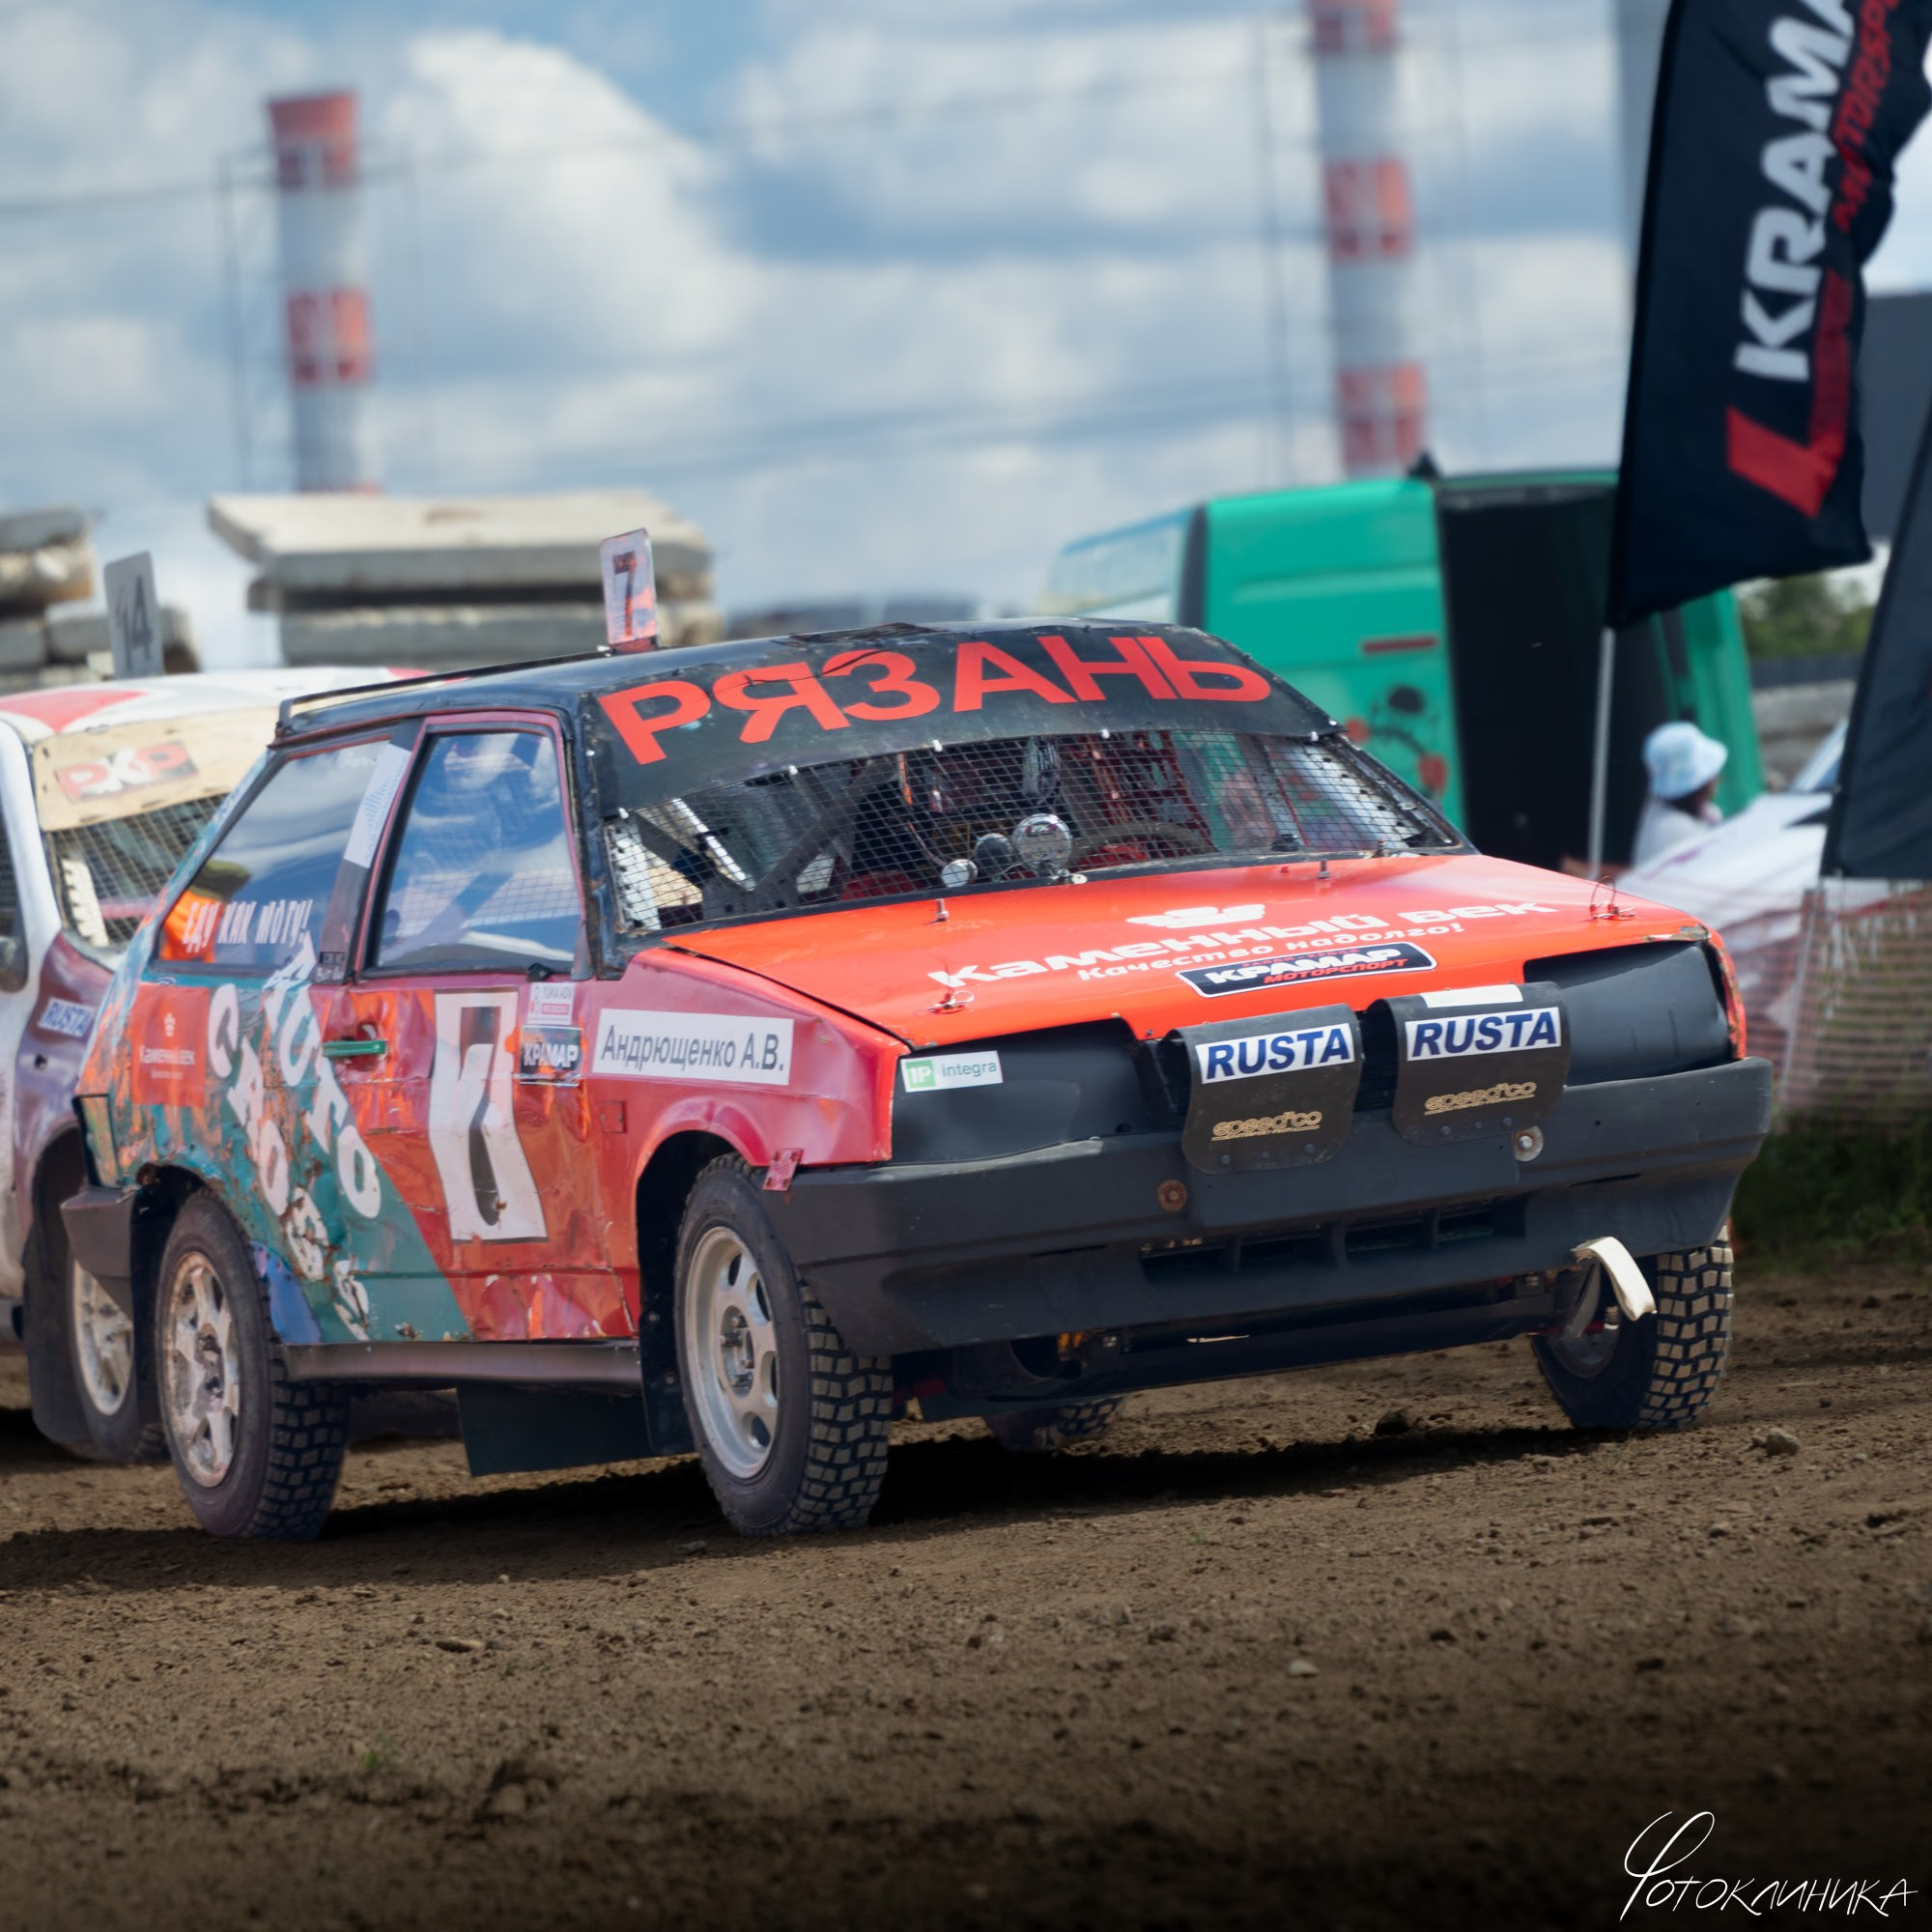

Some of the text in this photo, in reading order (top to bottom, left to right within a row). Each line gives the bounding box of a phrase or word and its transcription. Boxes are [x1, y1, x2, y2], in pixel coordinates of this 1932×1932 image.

[612, 550, 637, 638] 7
[599, 636, 1271, 765] РЯЗАНЬ
[928, 914, 1389, 988] Каменный
[1078, 923, 1464, 980] Качество надолго!
[1206, 949, 1401, 984] КРАМАР
[1264, 958, 1408, 984] МОТОРСПОРТ
[601, 1025, 784, 1071] Андрющенко А.В.
[1207, 1028, 1350, 1079] RUSTA
[1412, 1011, 1557, 1058] RUSTA
[942, 1062, 997, 1077] integra
